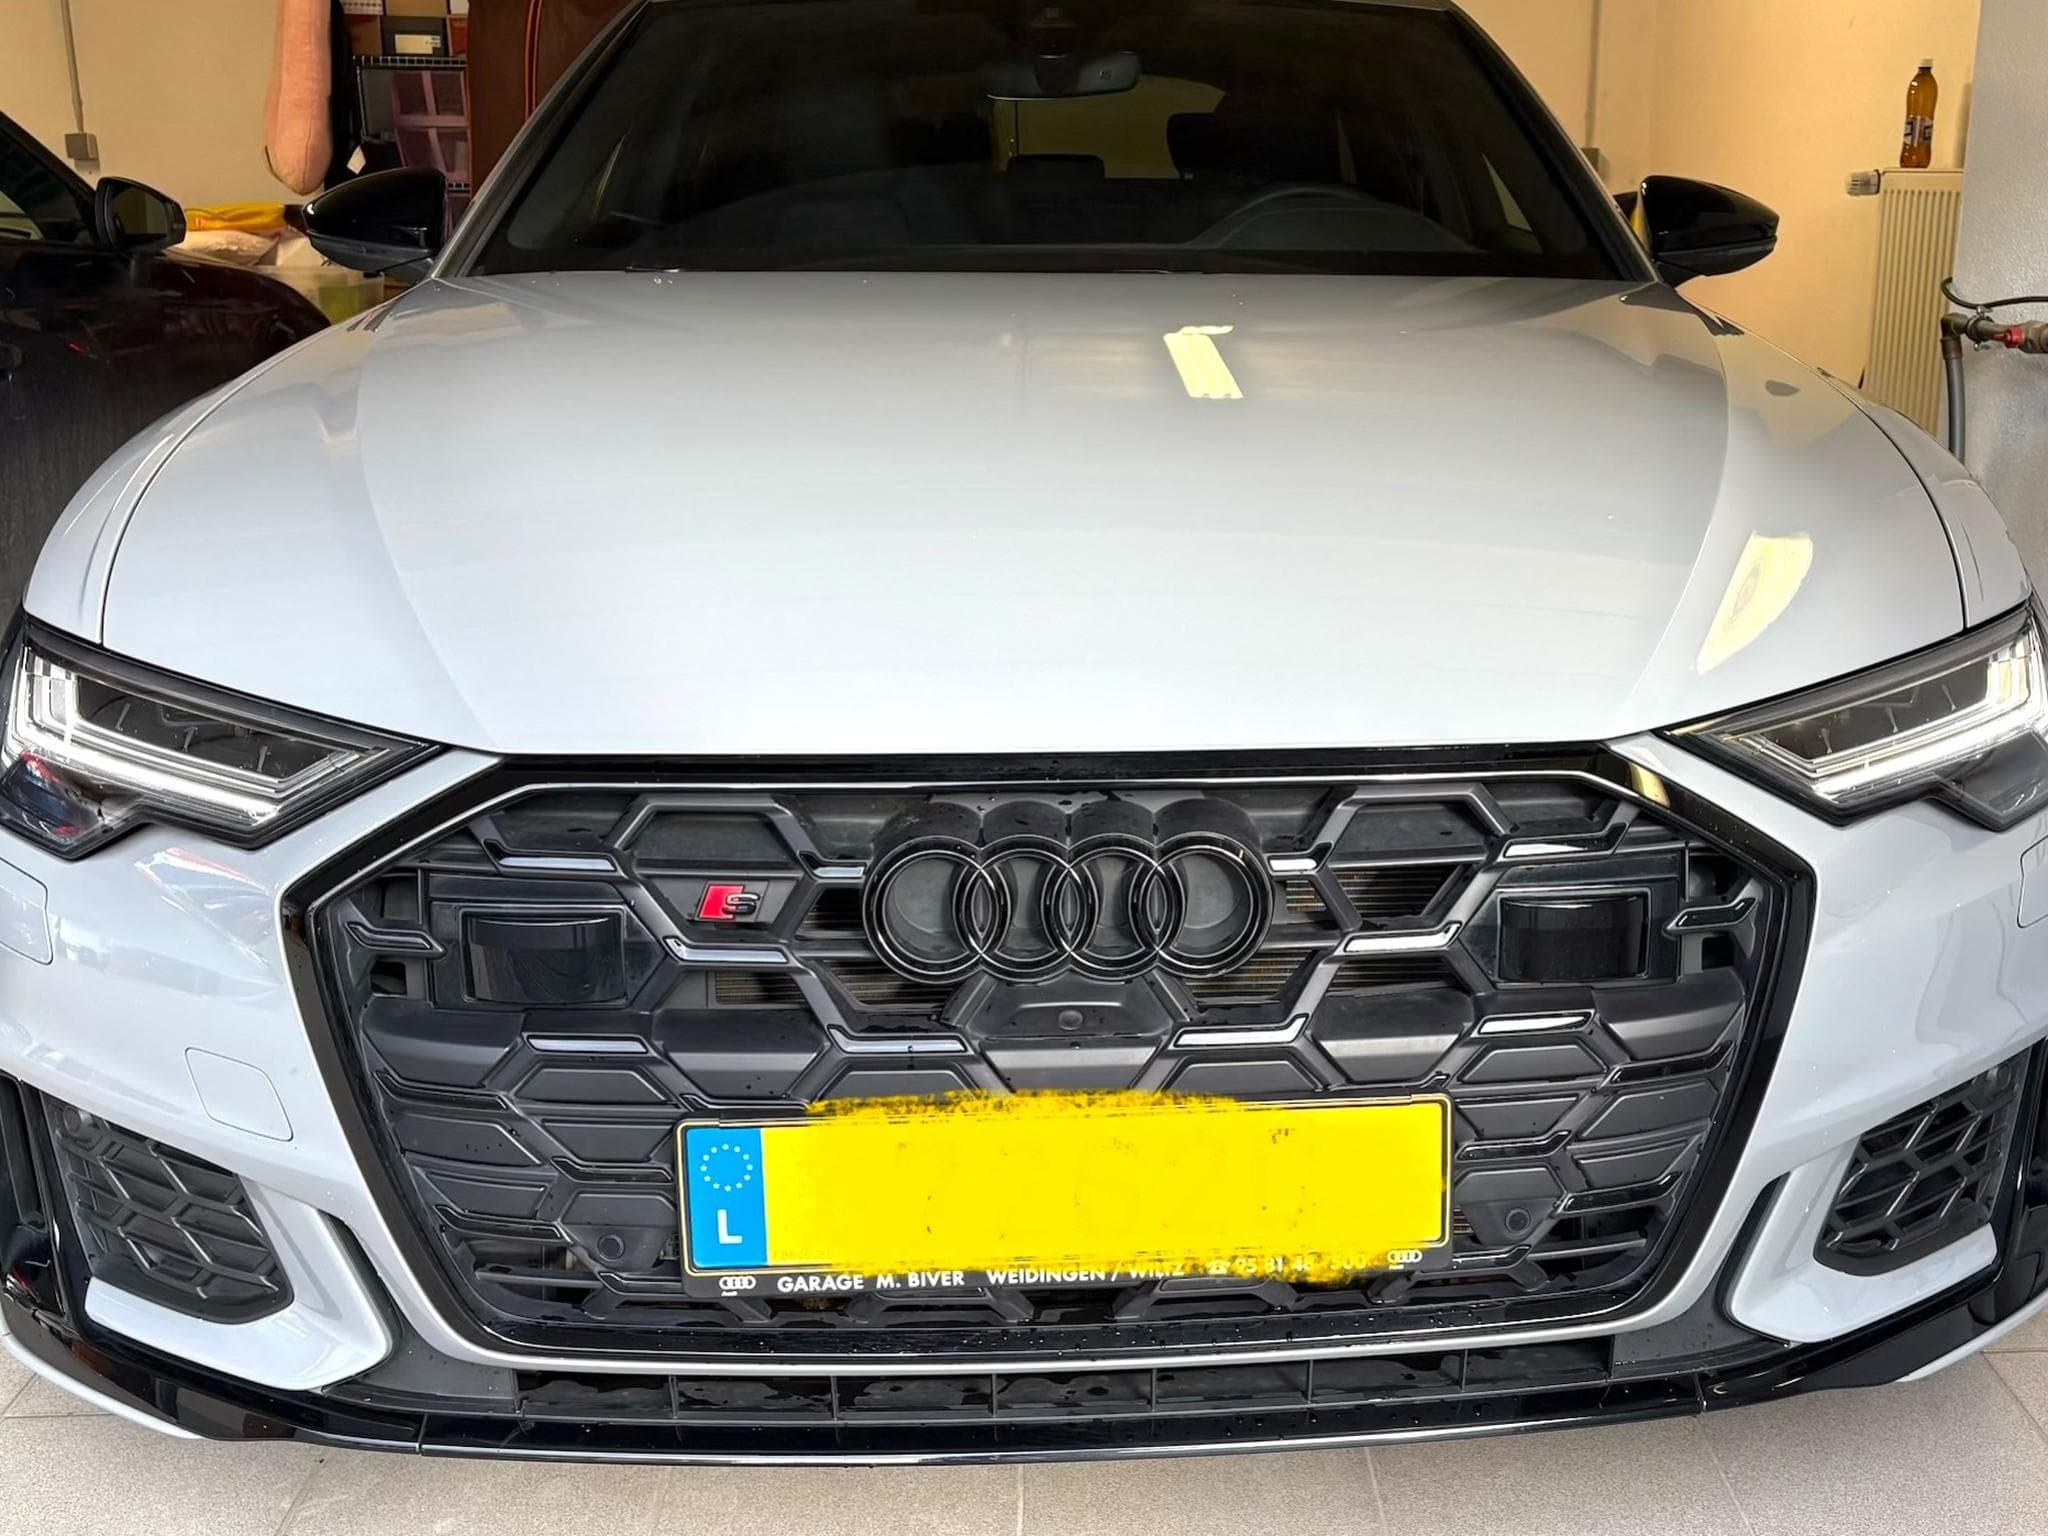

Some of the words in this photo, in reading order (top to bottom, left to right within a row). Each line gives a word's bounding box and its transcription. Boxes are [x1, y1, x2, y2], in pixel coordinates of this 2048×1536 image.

[721, 891, 761, 915] S
[717, 1209, 743, 1245] L
[777, 1274, 865, 1292] GARAGE
[876, 1273, 902, 1289] M.
[908, 1270, 965, 1288] BIVER
[986, 1266, 1106, 1285] WEIDINGEN
